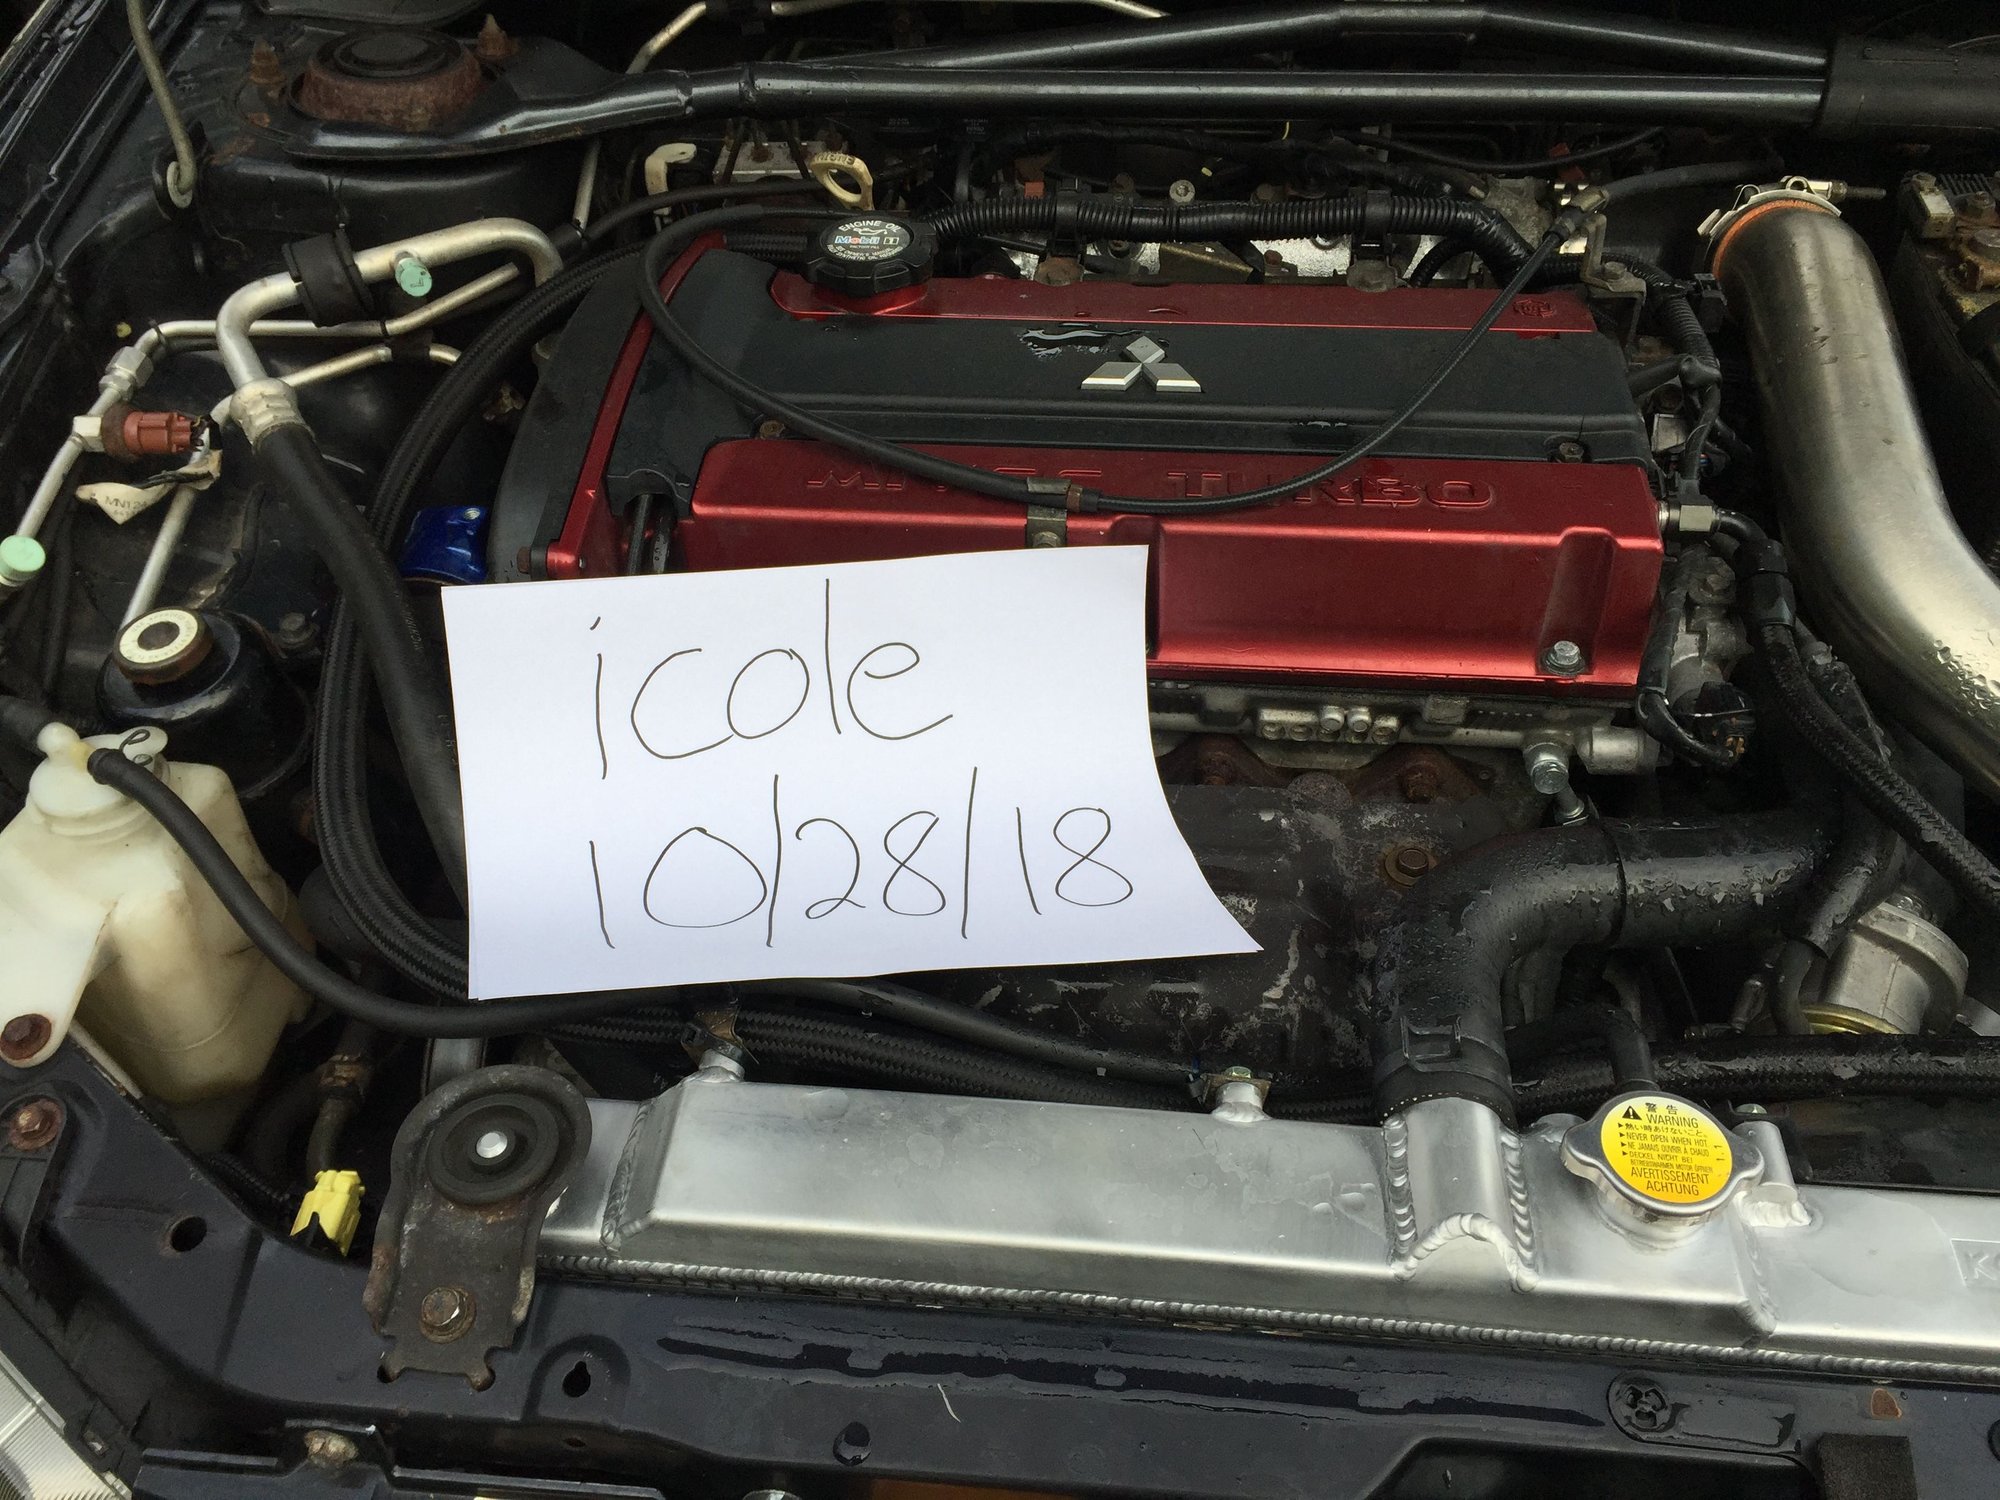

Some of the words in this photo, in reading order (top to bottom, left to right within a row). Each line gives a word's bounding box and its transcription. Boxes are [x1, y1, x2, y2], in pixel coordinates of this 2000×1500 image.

[838, 220, 881, 232] ENGINE
[885, 223, 901, 232] OIL
[834, 235, 880, 244] Mobil
[589, 766, 1134, 949] 10/28/18
[1645, 1102, 1678, 1115] 警告
[1646, 1113, 1699, 1128] WARNING
[1626, 1132, 1648, 1142] NEVER
[1650, 1134, 1669, 1144] OPEN
[1671, 1136, 1692, 1146] WHEN
[1628, 1141, 1636, 1149] NE
[1638, 1143, 1660, 1152] JAMAIS
[1661, 1145, 1682, 1155] OUVRIR
[1690, 1147, 1710, 1158] CHAUD
[1629, 1150, 1654, 1160] DECKEL
[1657, 1152, 1678, 1162] NICHT
[1631, 1166, 1710, 1185] AVERTISSEMENT
[1646, 1180, 1699, 1196] ACHTUNG
